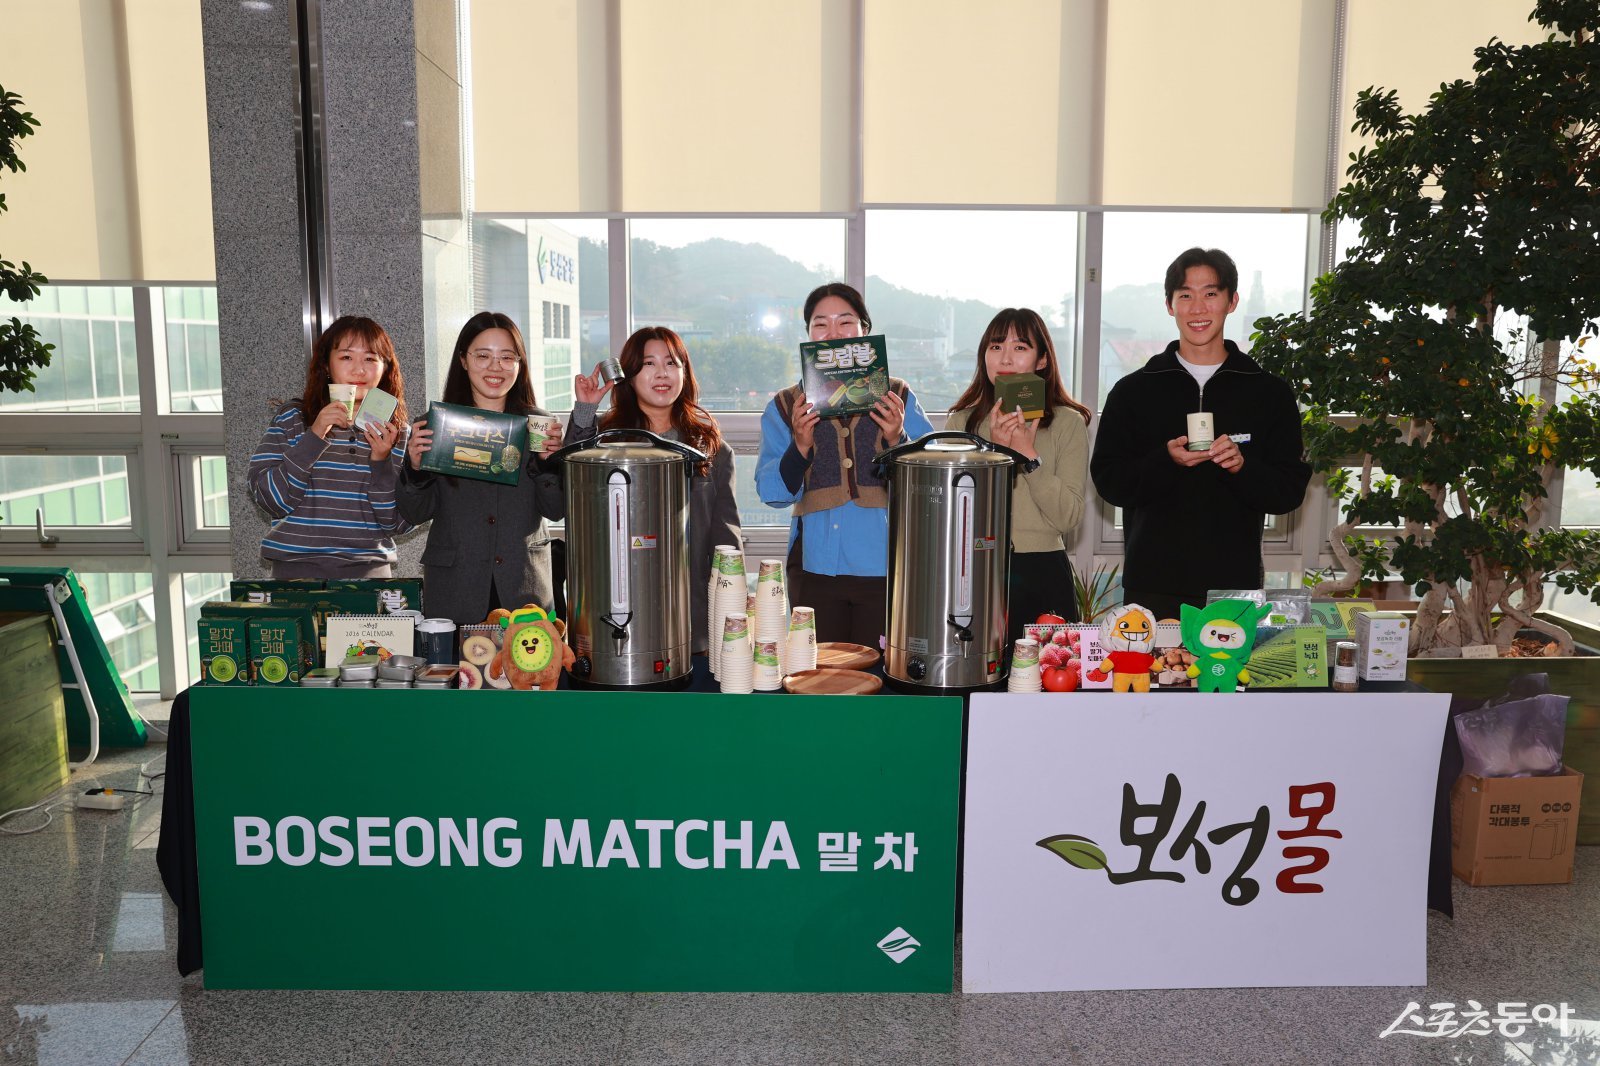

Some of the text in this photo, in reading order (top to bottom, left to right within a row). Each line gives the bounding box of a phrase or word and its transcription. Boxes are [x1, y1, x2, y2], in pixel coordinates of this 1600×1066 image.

[209, 627, 234, 641] 말차
[260, 628, 285, 642] 말차
[361, 630, 395, 638] CALENDAR
[210, 641, 233, 654] 라떼
[261, 642, 285, 655] 라떼
[1303, 643, 1319, 651] 보성
[1303, 651, 1319, 660] 녹차
[1489, 804, 1521, 815] 다목적
[1488, 816, 1531, 827] 각대봉투
[233, 815, 523, 868] BOSEONG
[542, 818, 801, 870] MATCHA
[1107, 772, 1343, 907] 보성몰
